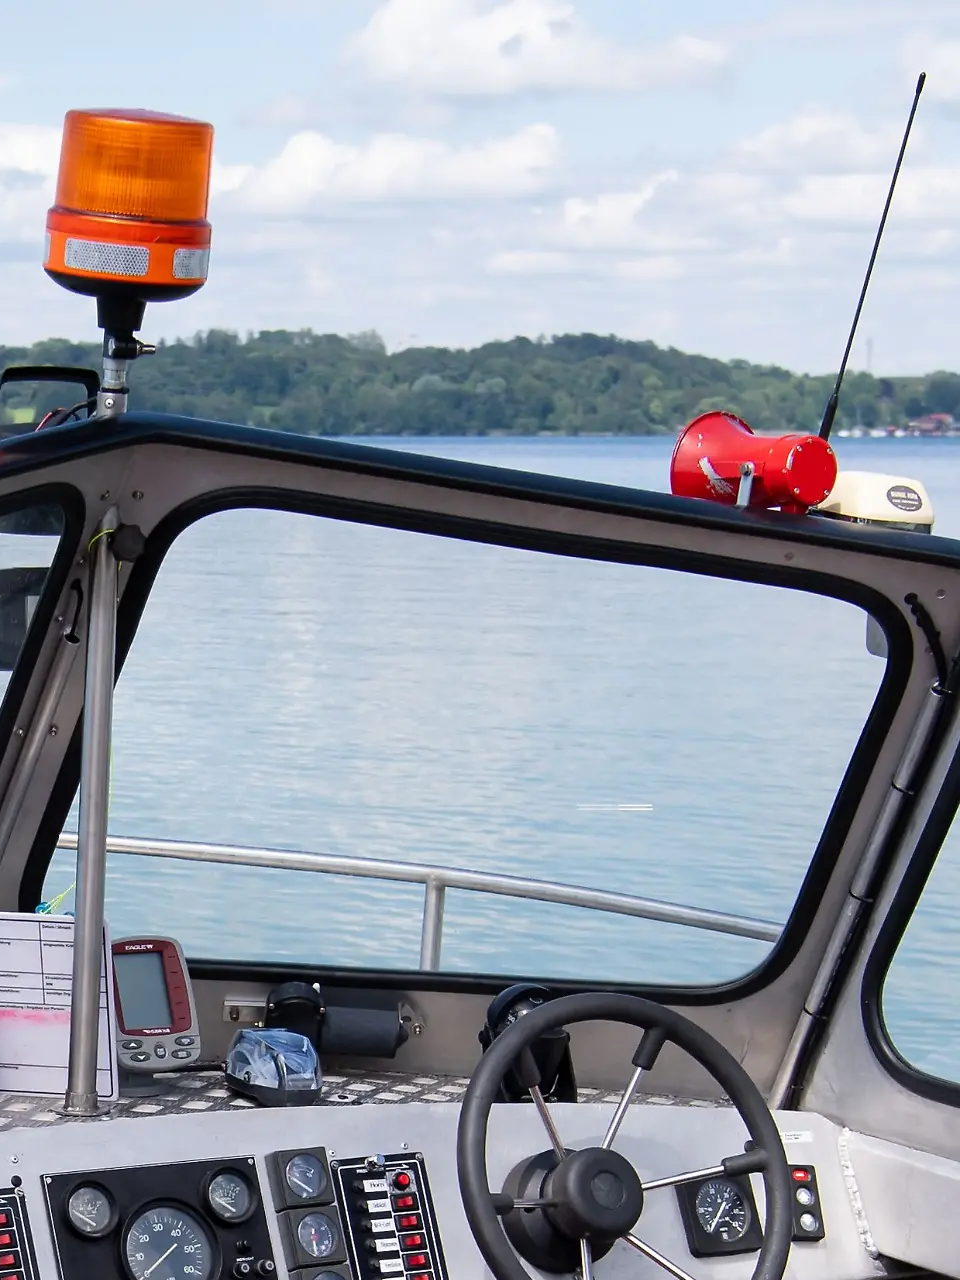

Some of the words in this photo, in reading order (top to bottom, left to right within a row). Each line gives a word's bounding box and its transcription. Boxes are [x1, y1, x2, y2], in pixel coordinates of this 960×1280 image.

[152, 1223, 163, 1232] 30
[170, 1229, 181, 1237] 40
[139, 1234, 149, 1243] 20
[184, 1245, 194, 1253] 50
[136, 1252, 144, 1260] 10
[183, 1265, 194, 1274] 60
